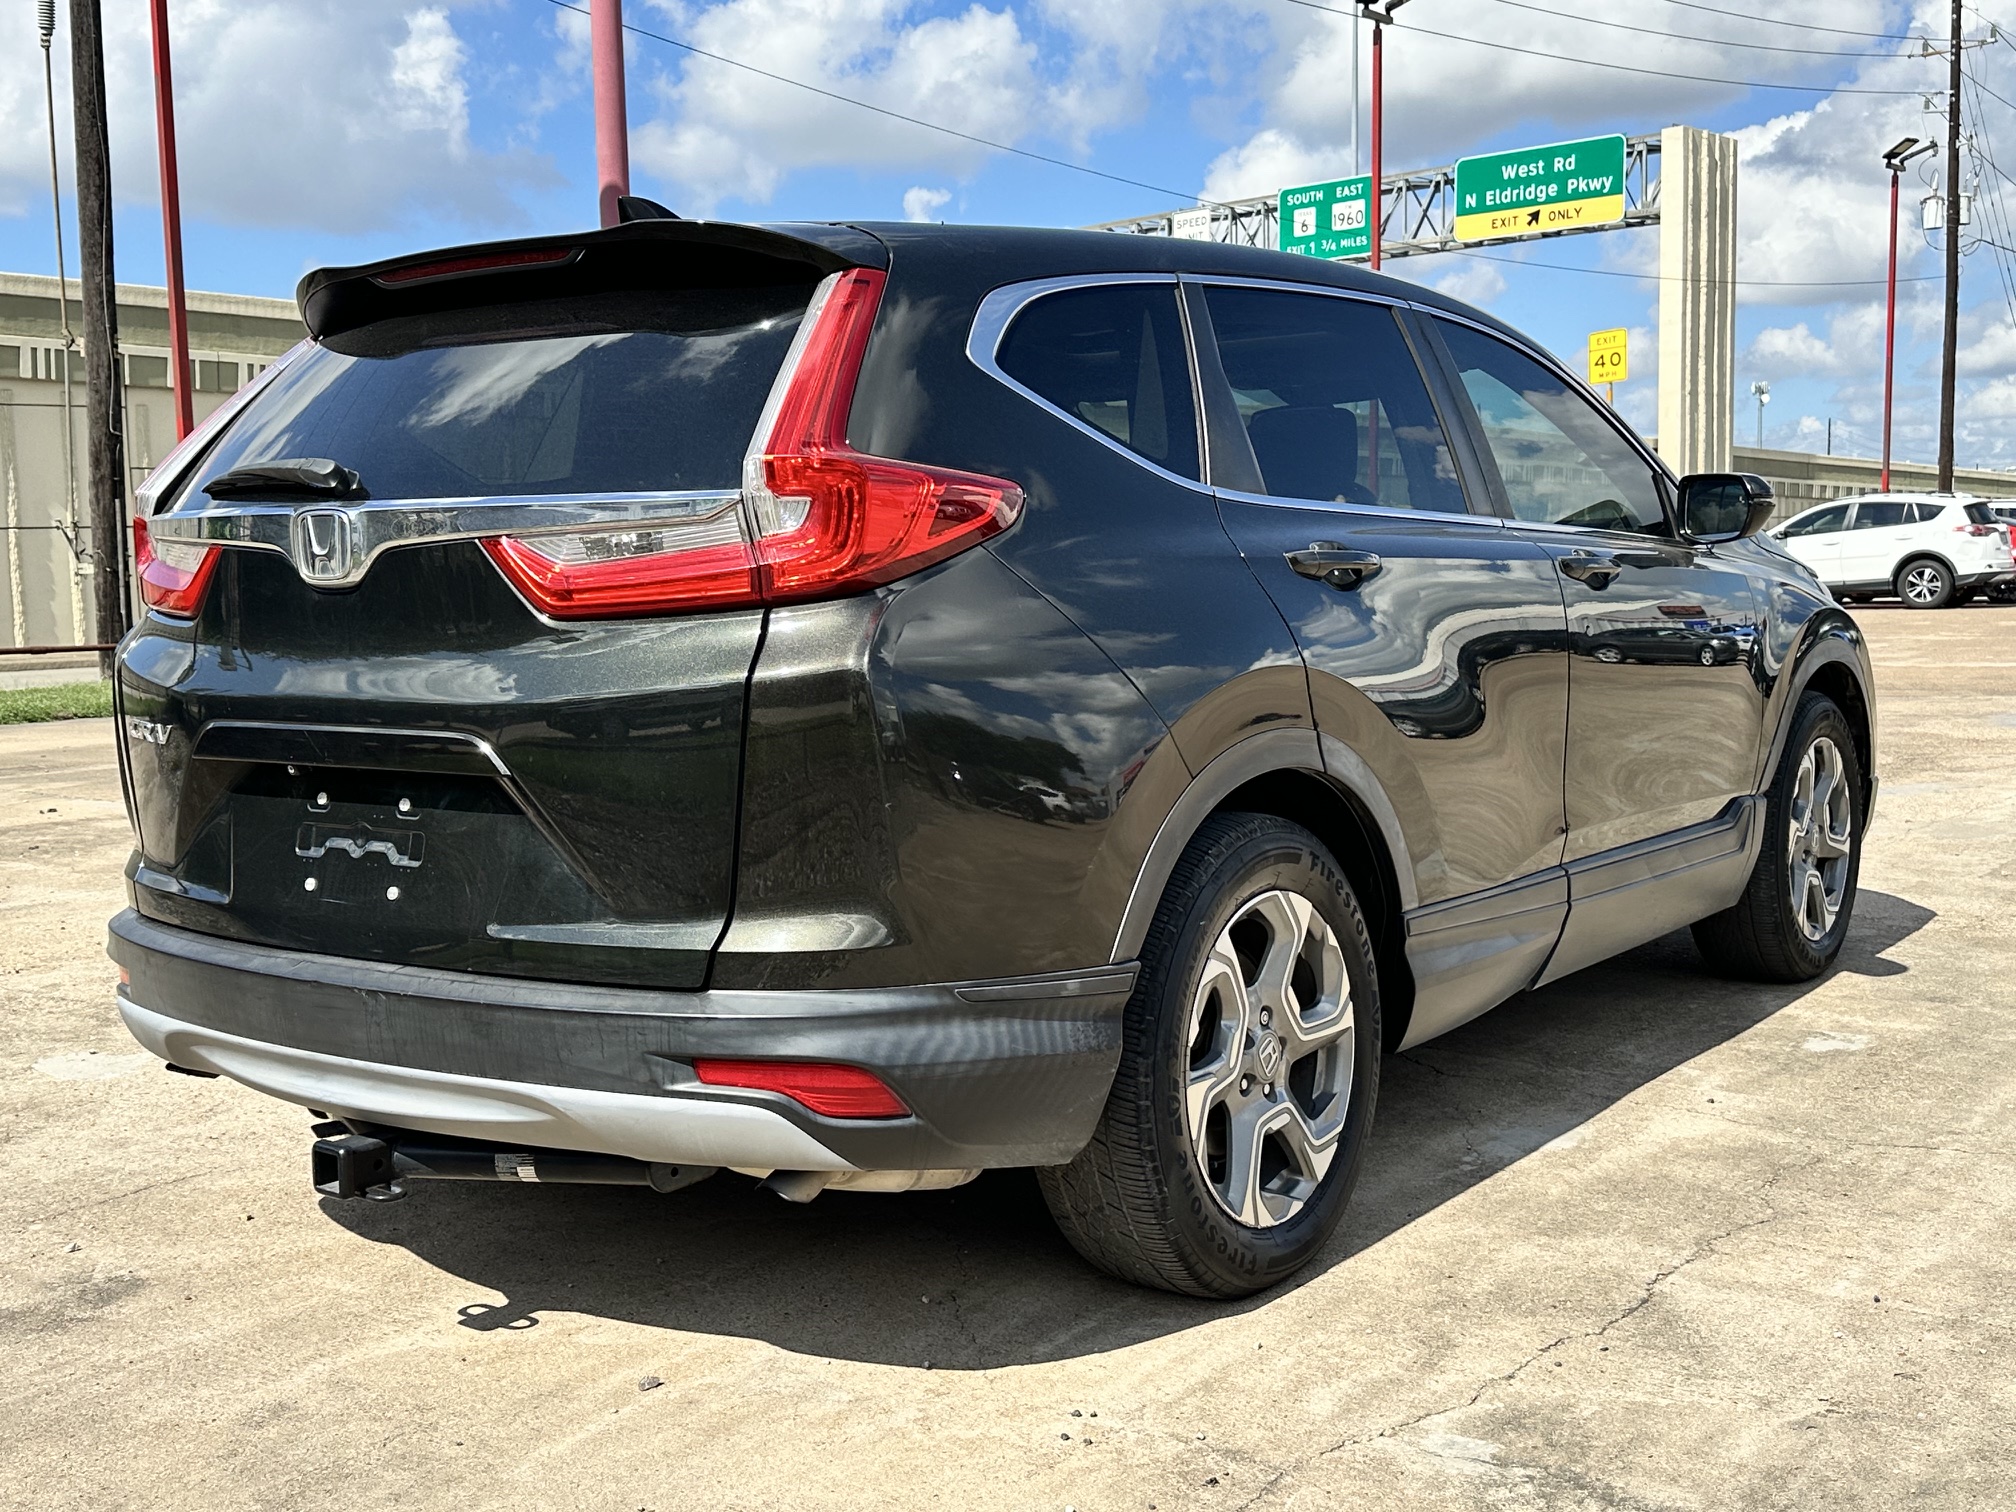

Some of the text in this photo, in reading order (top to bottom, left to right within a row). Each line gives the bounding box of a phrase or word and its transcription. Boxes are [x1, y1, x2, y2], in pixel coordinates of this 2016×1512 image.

[1501, 154, 1576, 181] West Rd
[1286, 183, 1364, 207] SOUTH EAST
[1465, 175, 1614, 209] N Eldridge Pkwy
[1176, 216, 1207, 230] SPEED
[1301, 219, 1309, 233] 6
[1333, 210, 1364, 228] 1960
[1491, 207, 1583, 230] EXIT ONLY
[1309, 241, 1316, 255] 1
[1321, 239, 1337, 252] 3/4
[1339, 236, 1368, 249] MILES
[1596, 335, 1617, 346] EXIT
[1594, 352, 1622, 368] 40
[1308, 850, 1376, 979] Firestone
[1177, 1150, 1258, 1276] Firestone
